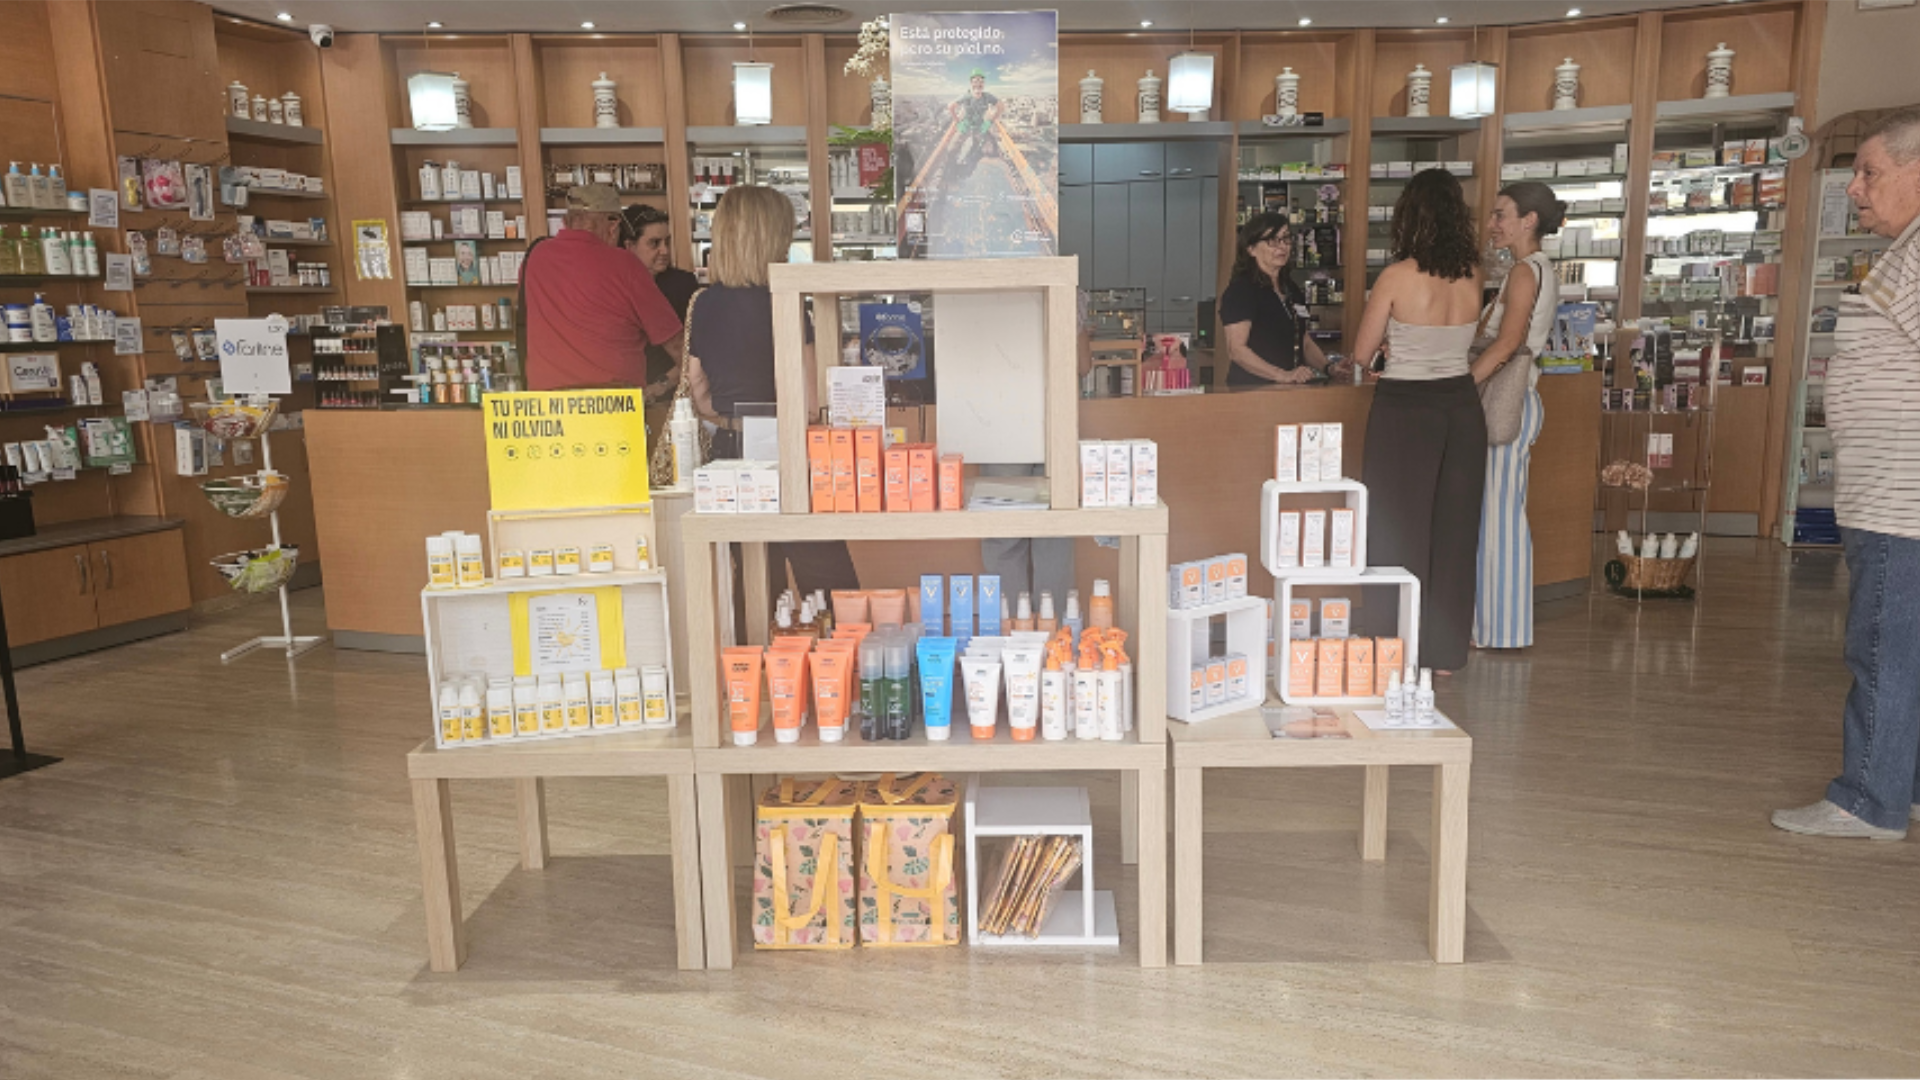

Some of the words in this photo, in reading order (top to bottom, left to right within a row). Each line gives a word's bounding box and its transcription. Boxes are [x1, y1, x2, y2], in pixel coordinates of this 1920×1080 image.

[899, 26, 930, 40] Está
[935, 44, 949, 55] su
[951, 42, 980, 56] piel
[491, 399, 510, 417] TU
[513, 398, 546, 417] PIEL
[549, 397, 564, 415] NI
[567, 395, 636, 415] PERDONA
[493, 421, 508, 439] NI
[512, 419, 565, 439] OLVIDA
